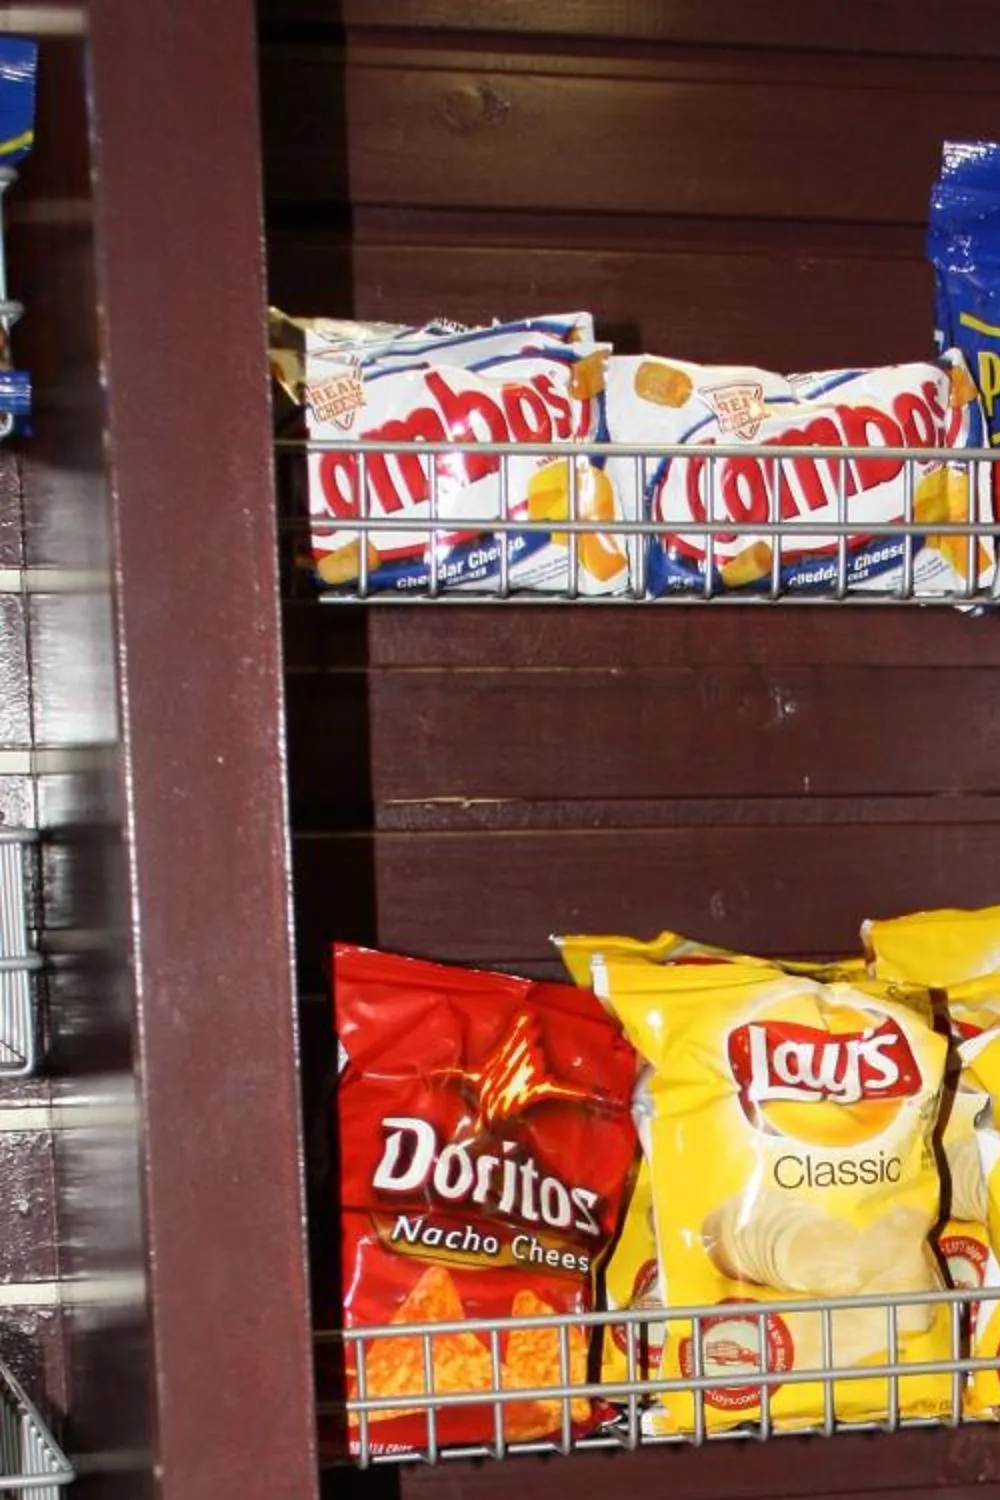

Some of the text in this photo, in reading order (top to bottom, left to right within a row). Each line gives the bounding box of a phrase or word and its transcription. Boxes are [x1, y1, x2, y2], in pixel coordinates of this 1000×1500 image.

[310, 371, 574, 537] ombos
[396, 560, 464, 588] Chedar
[748, 1022, 899, 1104] Lay's
[373, 1115, 601, 1236] Doritos
[773, 1153, 901, 1189] Classic
[392, 1215, 499, 1255] Nacho
